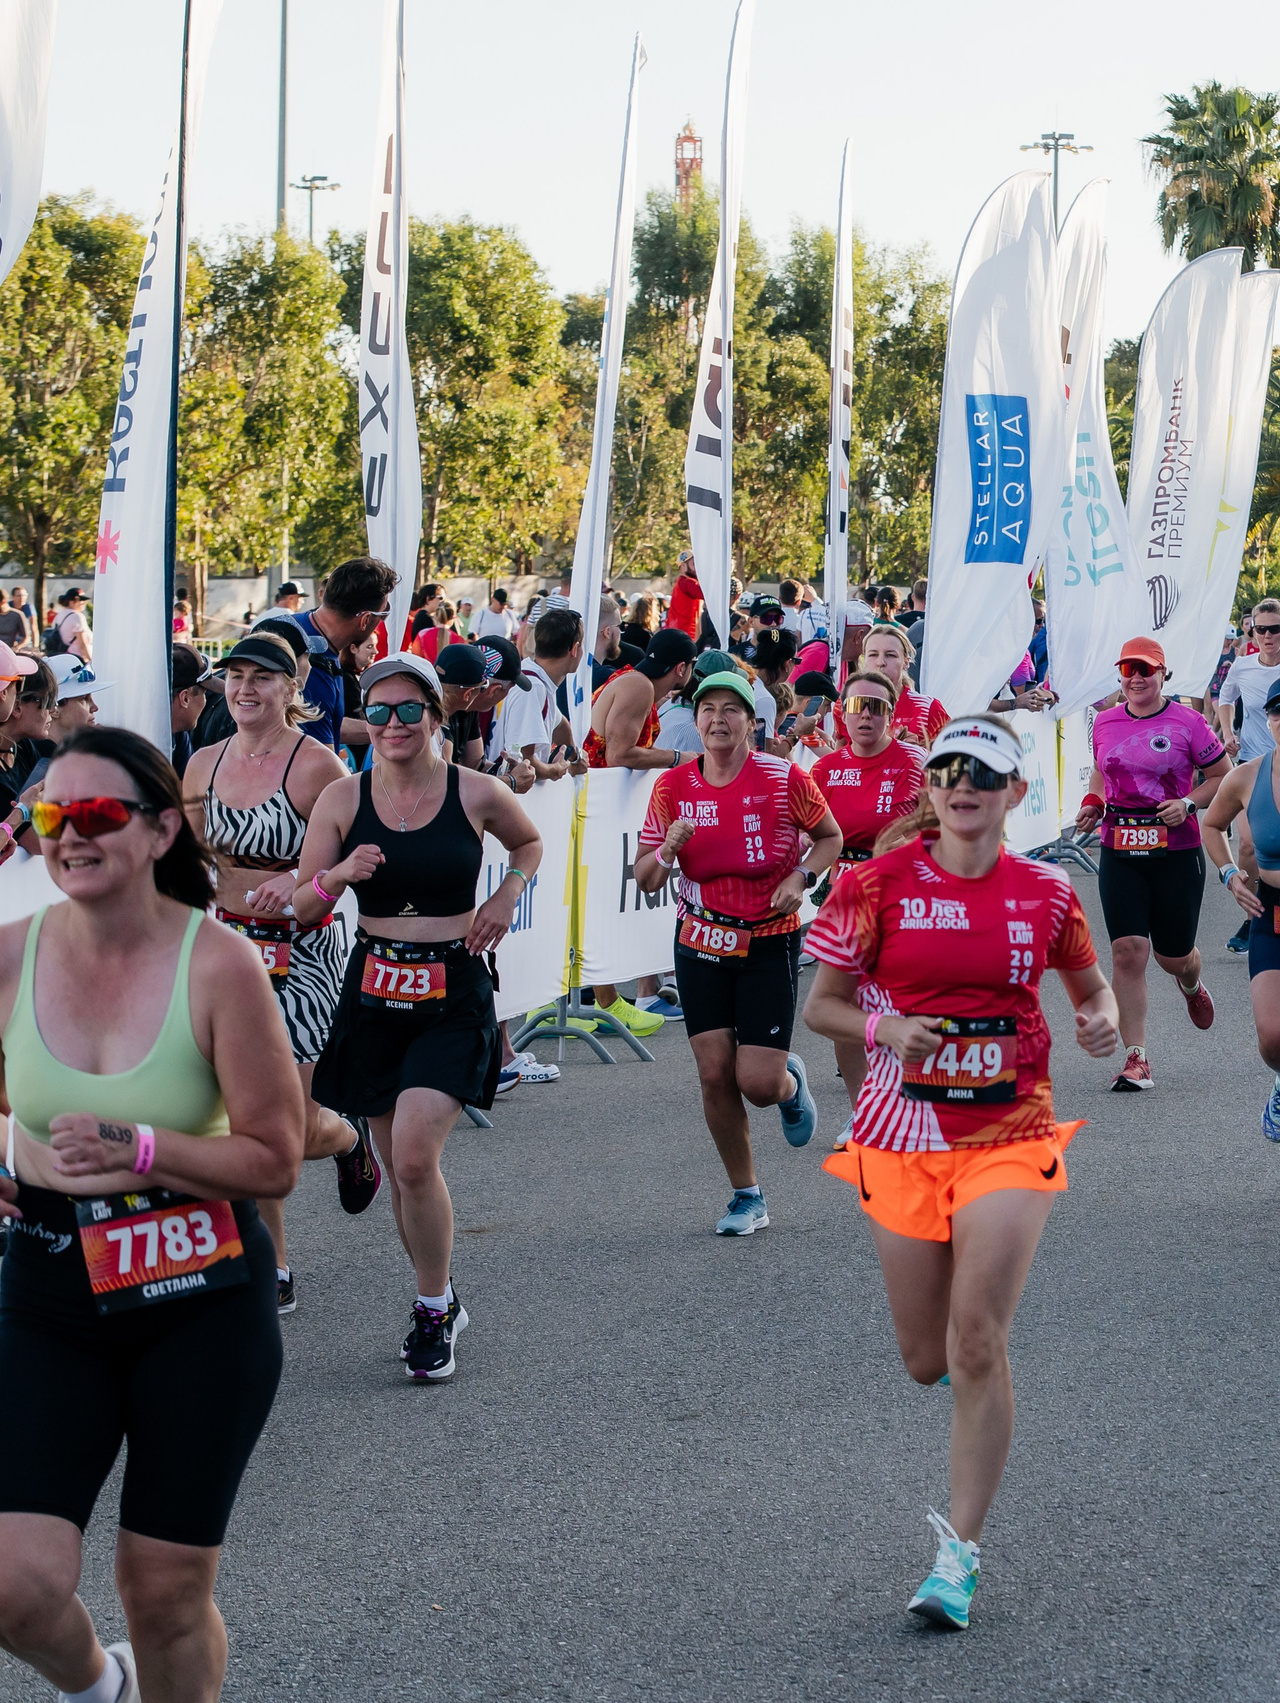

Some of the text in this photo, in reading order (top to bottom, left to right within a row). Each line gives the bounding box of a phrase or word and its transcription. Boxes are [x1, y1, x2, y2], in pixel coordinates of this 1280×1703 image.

[1147, 377, 1184, 559] ГАЗПРОМБАНК
[973, 411, 991, 545] STELLAR
[1001, 414, 1025, 545] AQUA
[1168, 440, 1194, 559] ПРЕМИУМ
[943, 726, 998, 744] IRONMAN
[828, 769, 841, 780] 10
[844, 779, 861, 787] SOCHI
[877, 795, 893, 804] 20
[678, 801, 694, 818] 10
[876, 804, 891, 814] 24
[699, 817, 719, 827] SOCHI
[743, 821, 761, 833] LADY
[745, 836, 763, 849] 20
[1120, 828, 1159, 847] 7398
[747, 849, 766, 863] 24
[899, 897, 926, 918] 10
[899, 918, 970, 930] SIRIUS SOCHI
[1007, 921, 1027, 931] IRON
[690, 920, 738, 952] 7189
[1008, 930, 1034, 945] LADY
[697, 951, 720, 963] ЛАРИСА
[1010, 950, 1034, 967] 20
[374, 962, 431, 995] 7723
[1009, 969, 1030, 984] 24
[385, 1000, 414, 1010] КСЕНИЯ
[521, 1073, 550, 1081] crocs
[947, 1088, 974, 1099] АННА
[98, 1122, 133, 1145] 8639
[92, 1206, 113, 1221] LADY
[106, 1210, 219, 1275] 7783
[142, 1273, 207, 1299] СВЕТЛАНА
